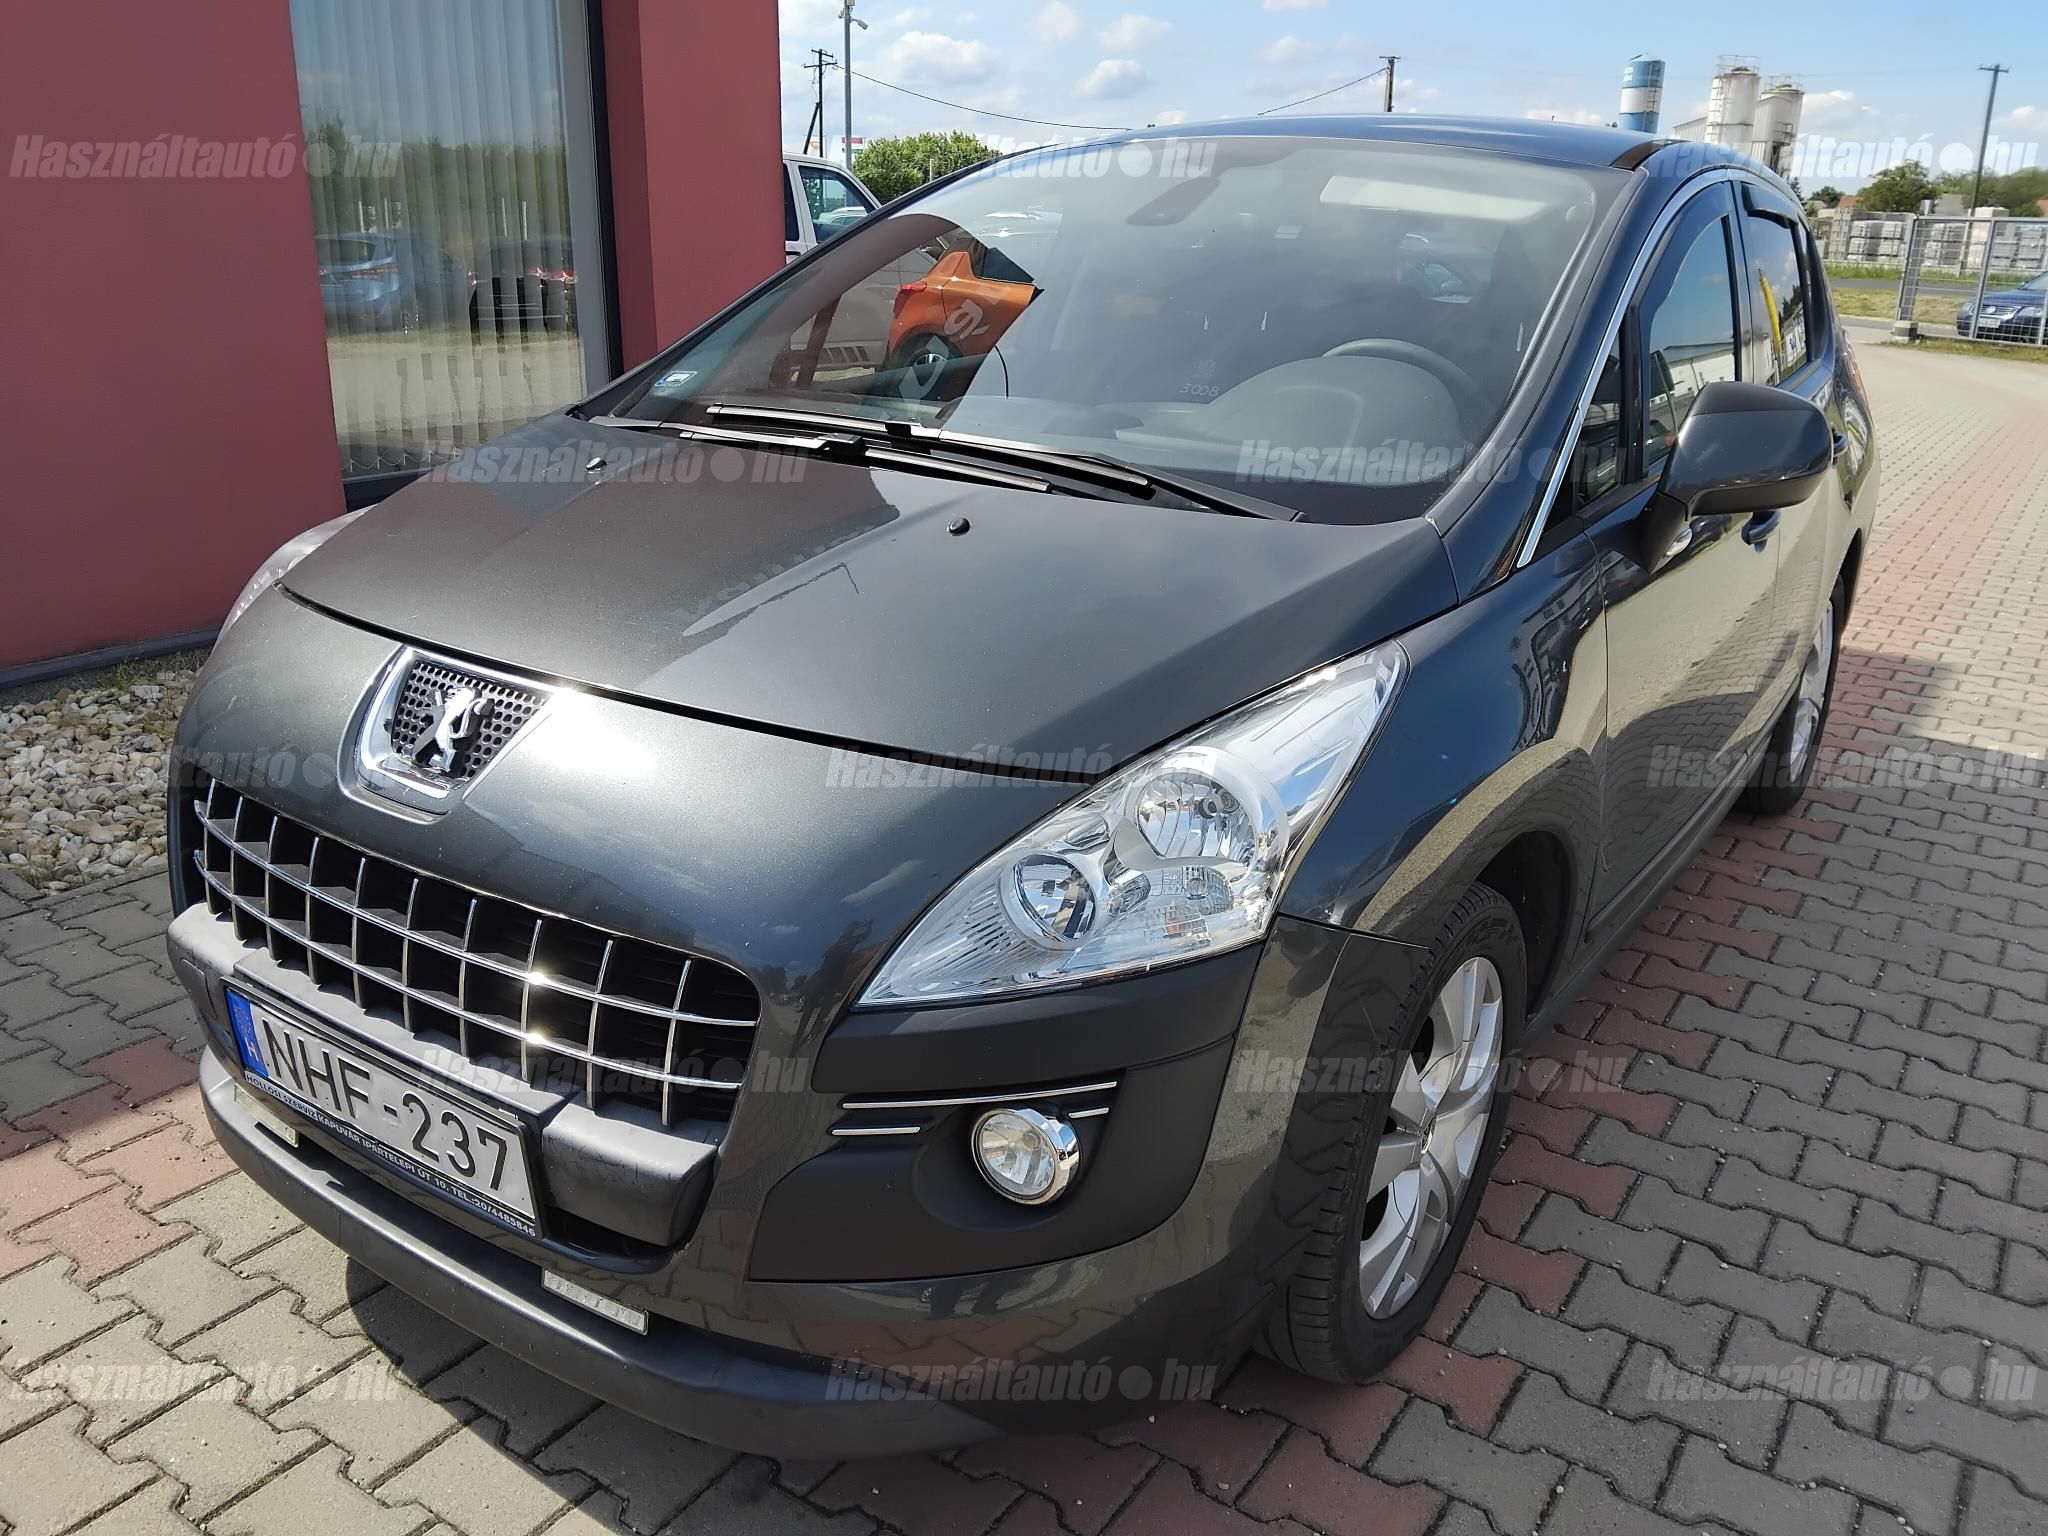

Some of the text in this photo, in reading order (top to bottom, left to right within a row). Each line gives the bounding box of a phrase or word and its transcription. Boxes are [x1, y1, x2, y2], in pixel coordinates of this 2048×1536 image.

[1179, 383, 1220, 397] 3008
[244, 1037, 259, 1062] H
[262, 1017, 507, 1191] NHF-237
[283, 1095, 317, 1118] SZERVIZ
[361, 1139, 415, 1174] IPARTELEPI
[434, 1178, 449, 1191] 10.
